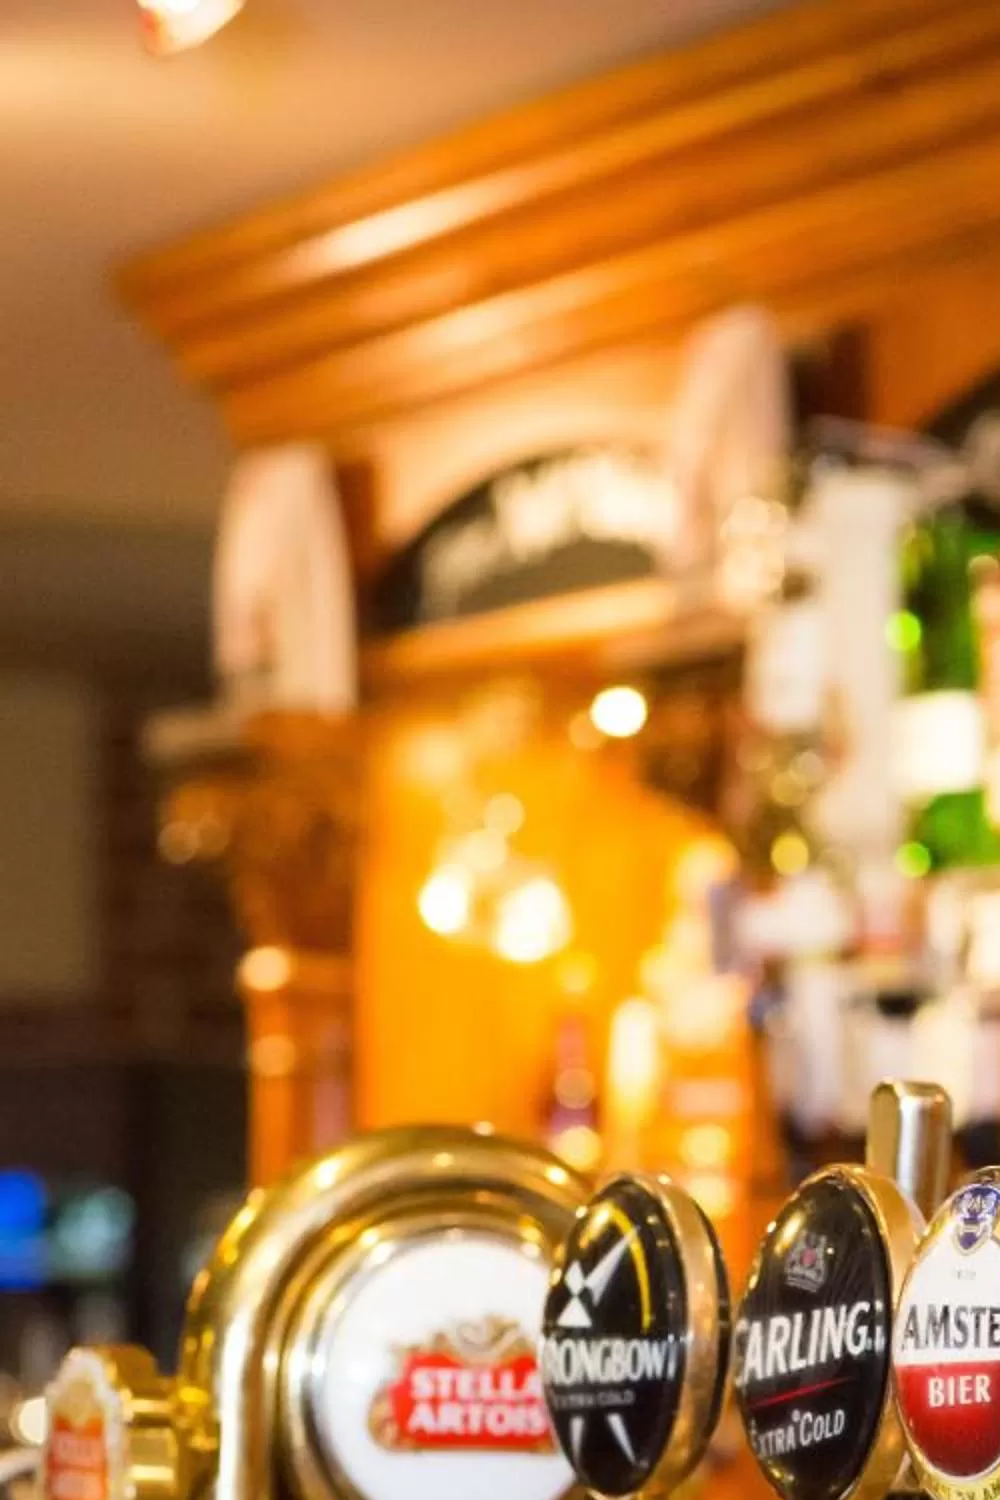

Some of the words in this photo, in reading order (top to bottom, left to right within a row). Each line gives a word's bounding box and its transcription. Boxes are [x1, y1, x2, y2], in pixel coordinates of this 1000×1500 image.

[734, 1301, 871, 1388] CARLING
[411, 1367, 543, 1400] STELLA
[928, 1374, 992, 1408] BIER
[408, 1401, 550, 1435] ARTOIS
[801, 1408, 846, 1446] COLD
